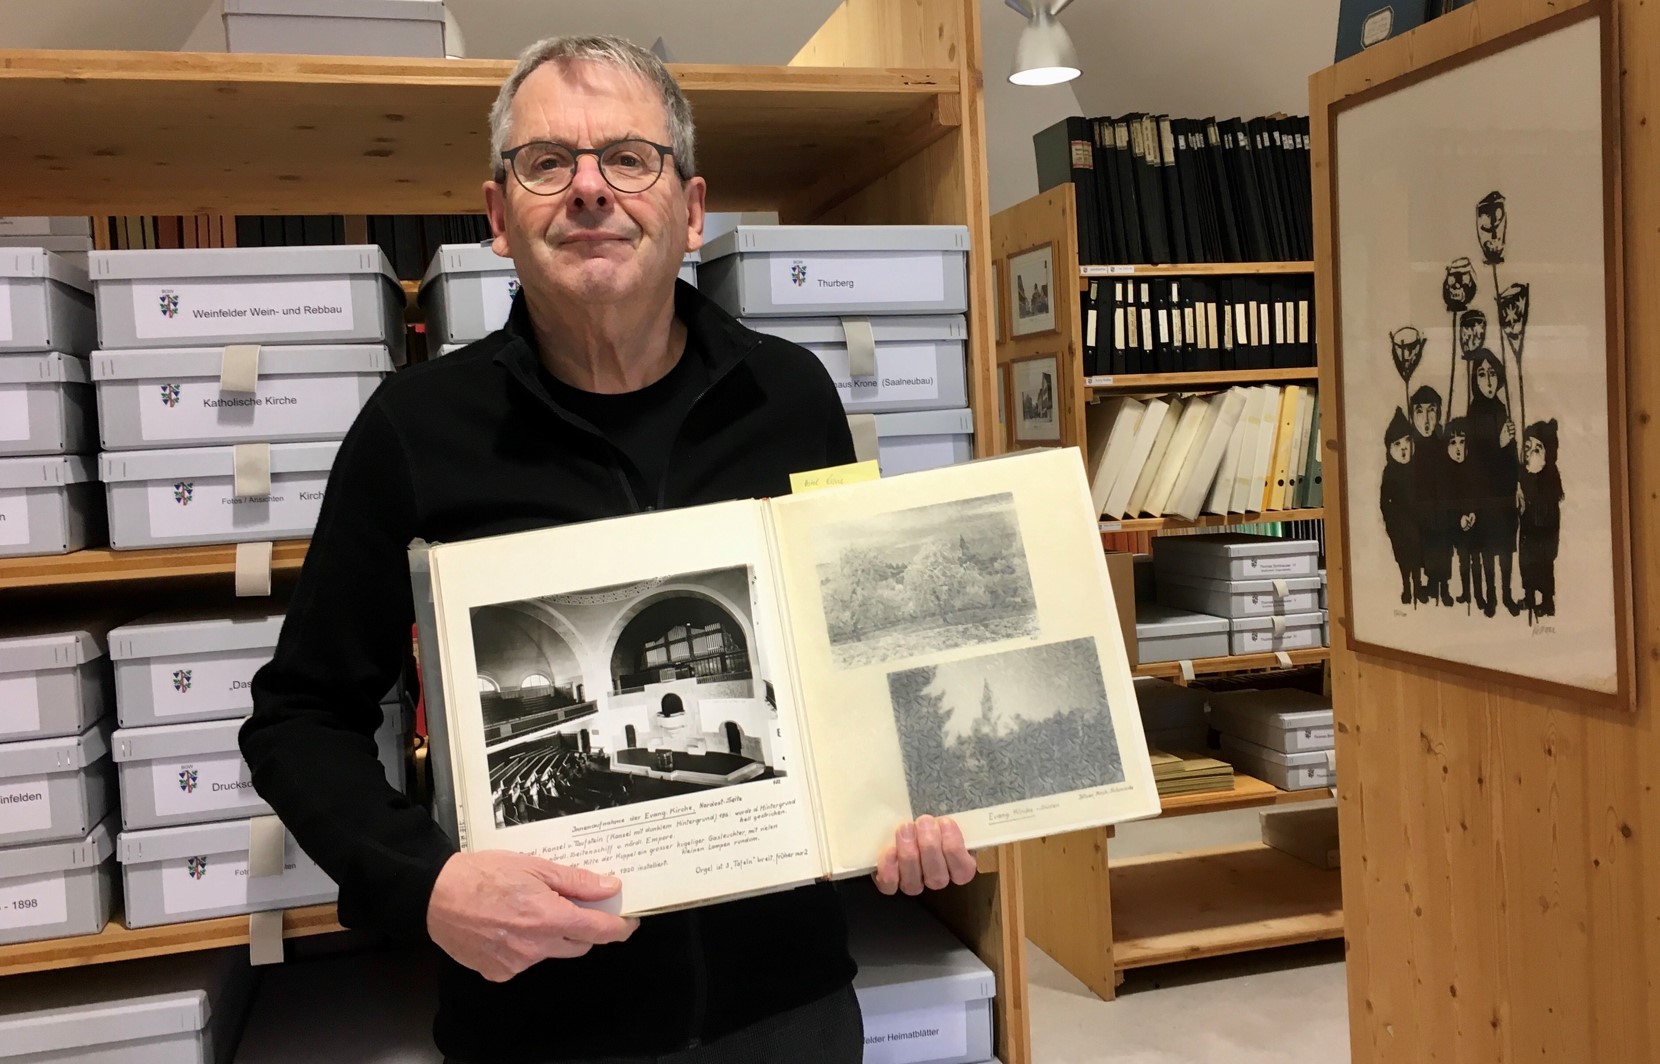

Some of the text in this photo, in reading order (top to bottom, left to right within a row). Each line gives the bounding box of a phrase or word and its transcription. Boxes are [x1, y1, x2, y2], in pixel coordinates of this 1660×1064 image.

[817, 278, 855, 289] Thurberg
[192, 305, 343, 319] Weinfelder Wein- und Rebbau
[853, 380, 878, 388] Krone
[881, 377, 934, 388] (Saalneubau)
[203, 396, 297, 408] Katholische Kirche
[221, 497, 243, 505] Fotos
[12, 898, 38, 910] 1898
[887, 1027, 940, 1042] Heimatblätter
